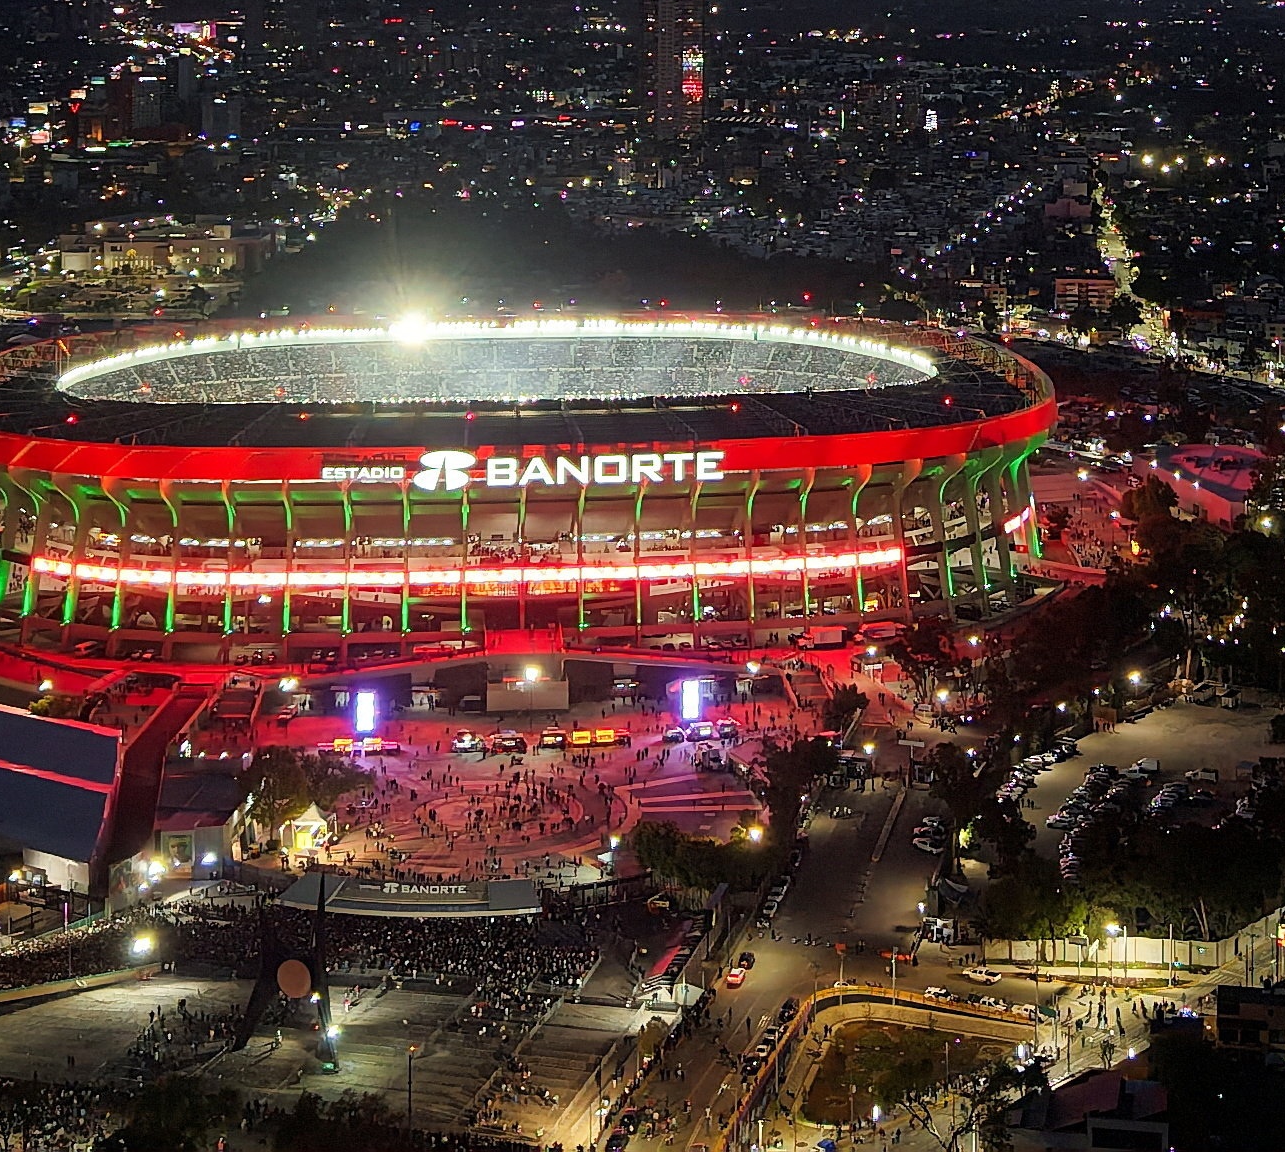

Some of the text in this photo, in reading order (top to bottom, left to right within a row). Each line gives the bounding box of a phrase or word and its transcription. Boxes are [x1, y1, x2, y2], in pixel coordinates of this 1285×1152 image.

[322, 451, 725, 487] ESTADIO BANORTE
[401, 884, 467, 894] BANORTE
